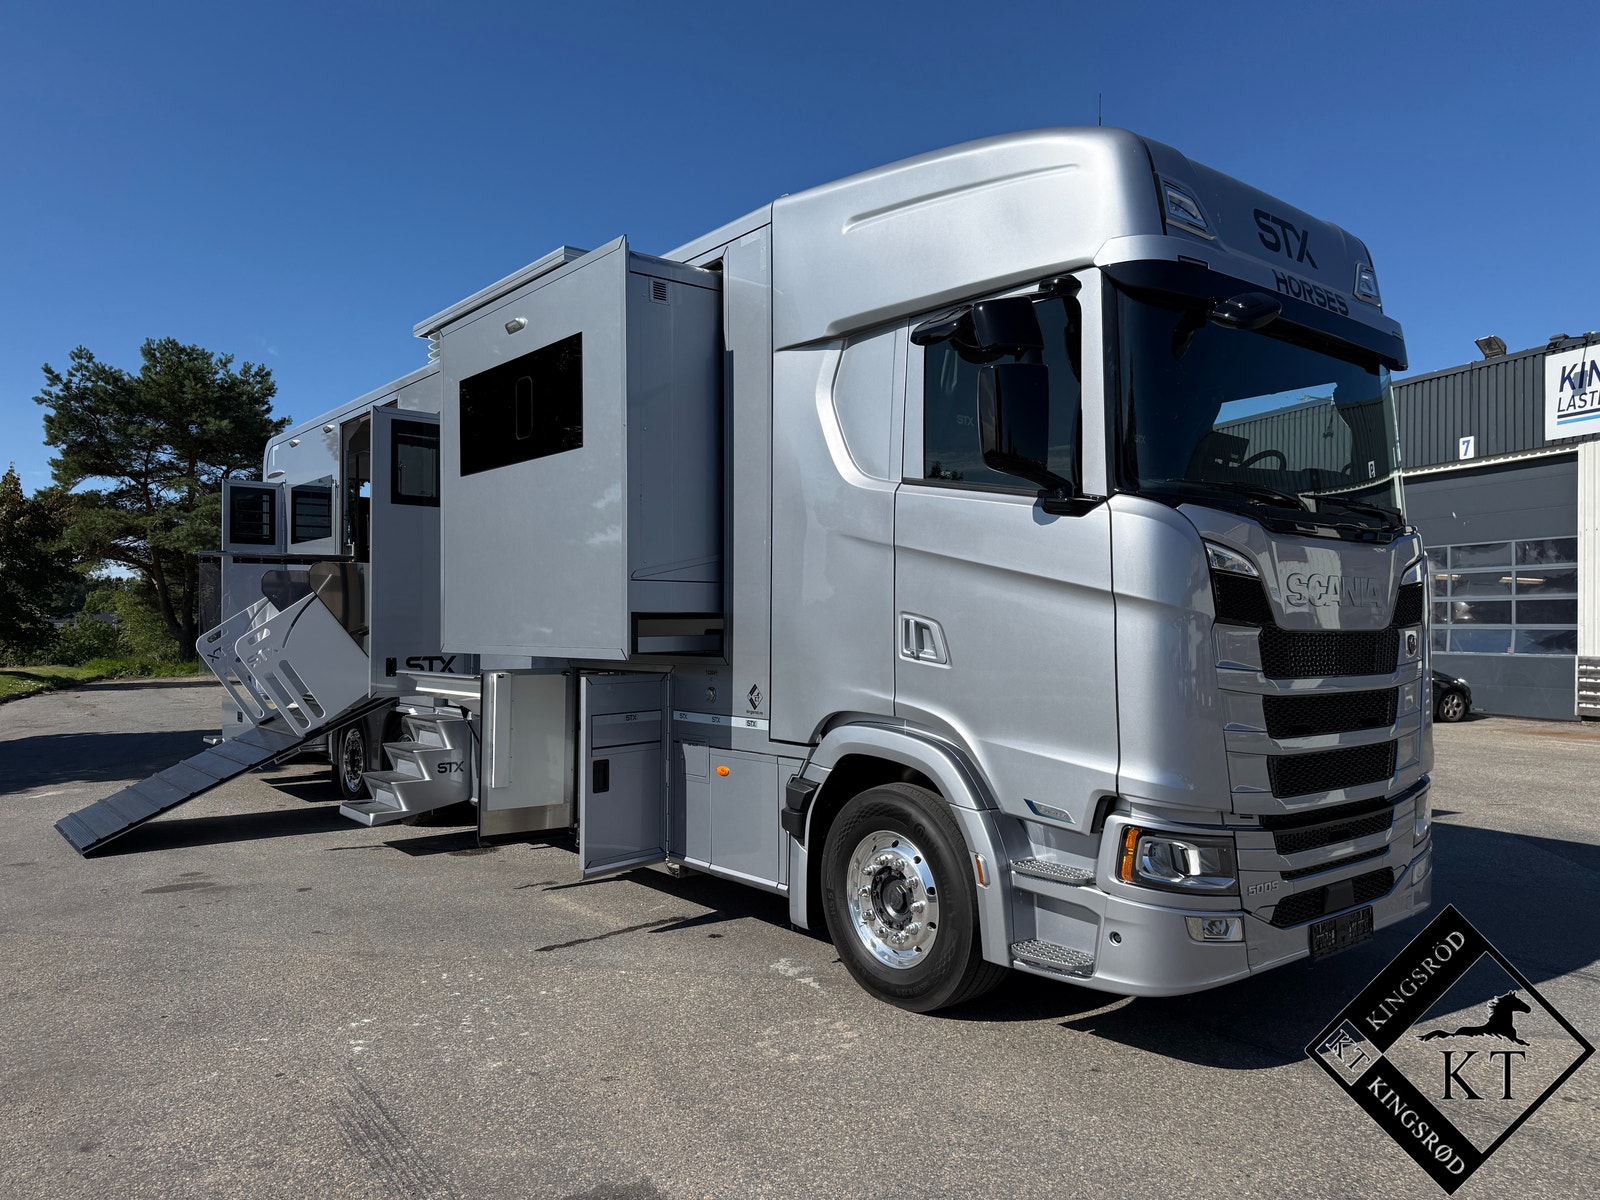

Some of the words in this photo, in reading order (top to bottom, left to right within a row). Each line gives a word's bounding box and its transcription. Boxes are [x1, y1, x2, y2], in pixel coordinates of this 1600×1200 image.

[1253, 208, 1318, 270] STX
[1272, 269, 1349, 316] HORSES
[1557, 390, 1600, 412] LAST
[956, 414, 975, 426] STX
[1462, 439, 1471, 456] 7
[1286, 573, 1384, 607] SCANIA
[406, 656, 456, 673] STX
[437, 761, 464, 773] STX
[1248, 881, 1279, 896] 500S
